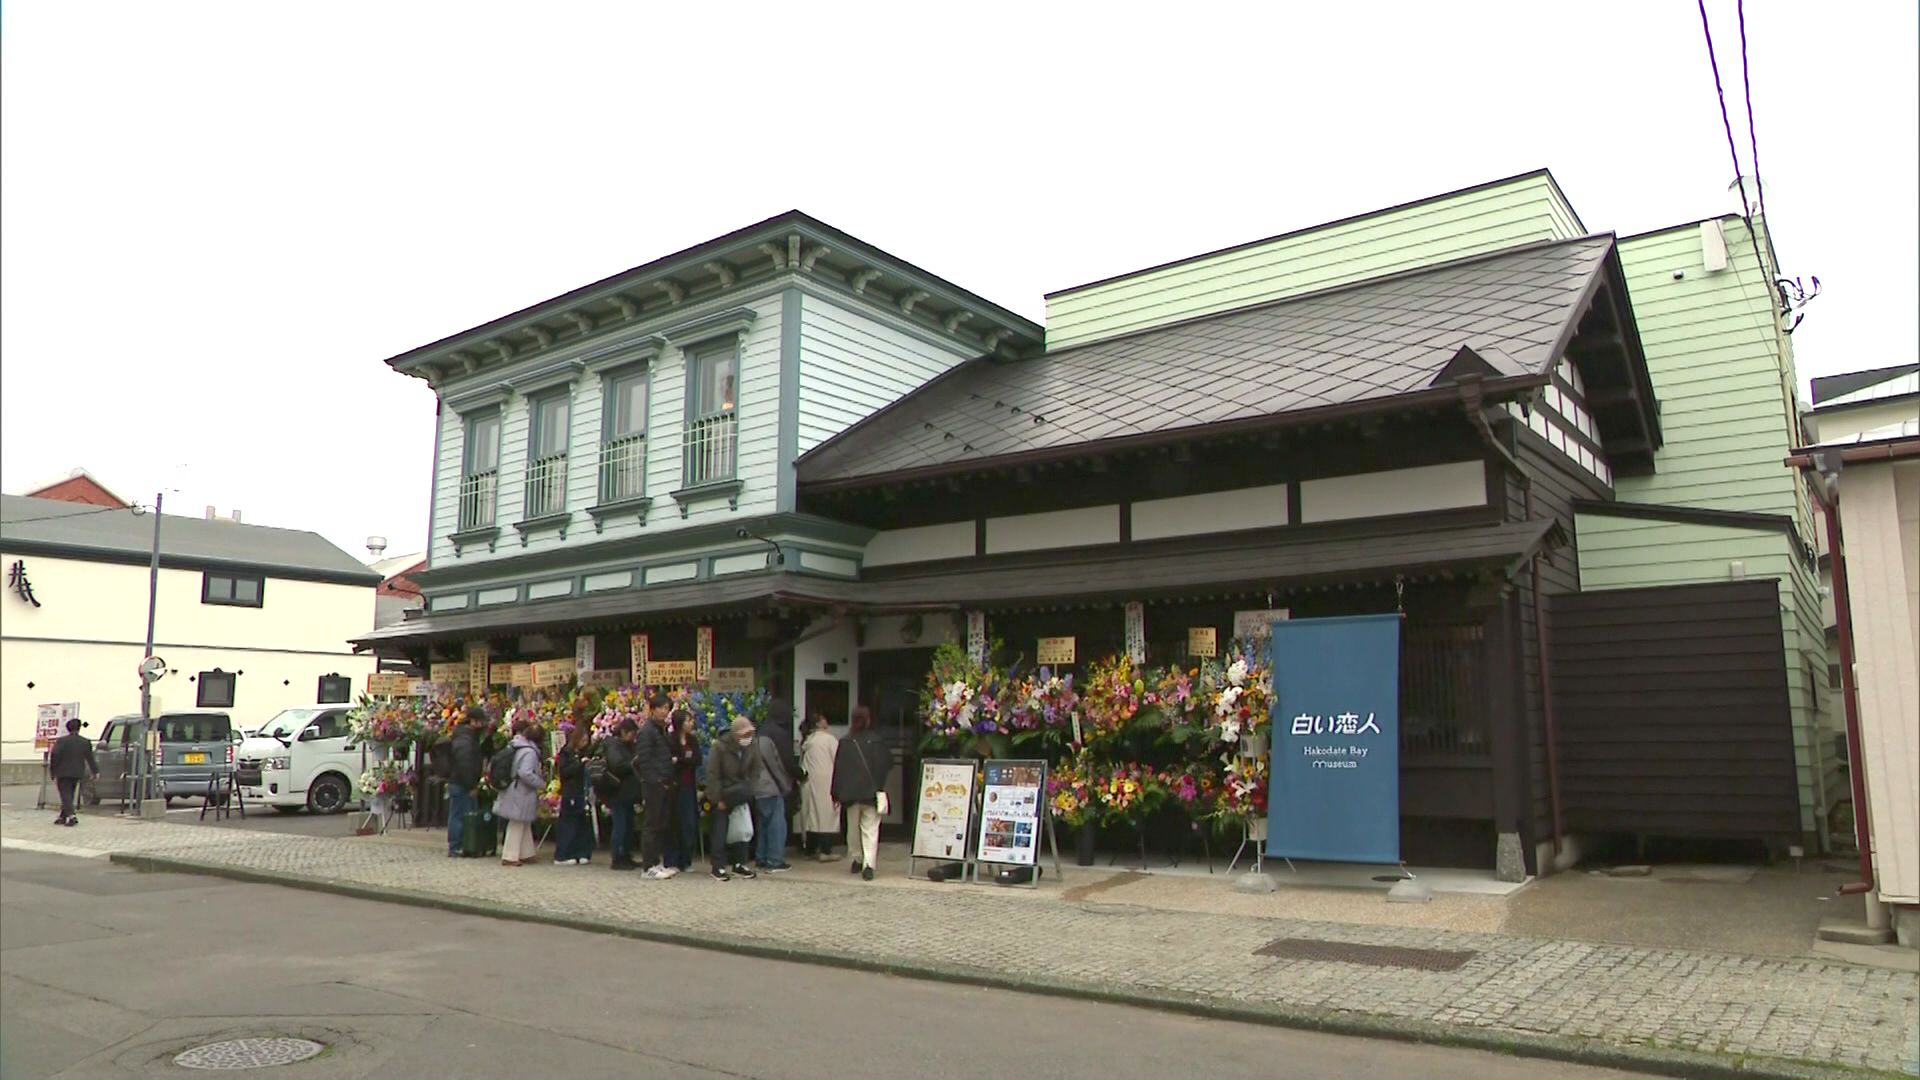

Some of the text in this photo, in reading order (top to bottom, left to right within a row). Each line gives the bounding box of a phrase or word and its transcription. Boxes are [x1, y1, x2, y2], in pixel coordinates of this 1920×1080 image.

[1291, 712, 1381, 735] 白い恋人
[1303, 746, 1368, 757] Hakodate Bay
